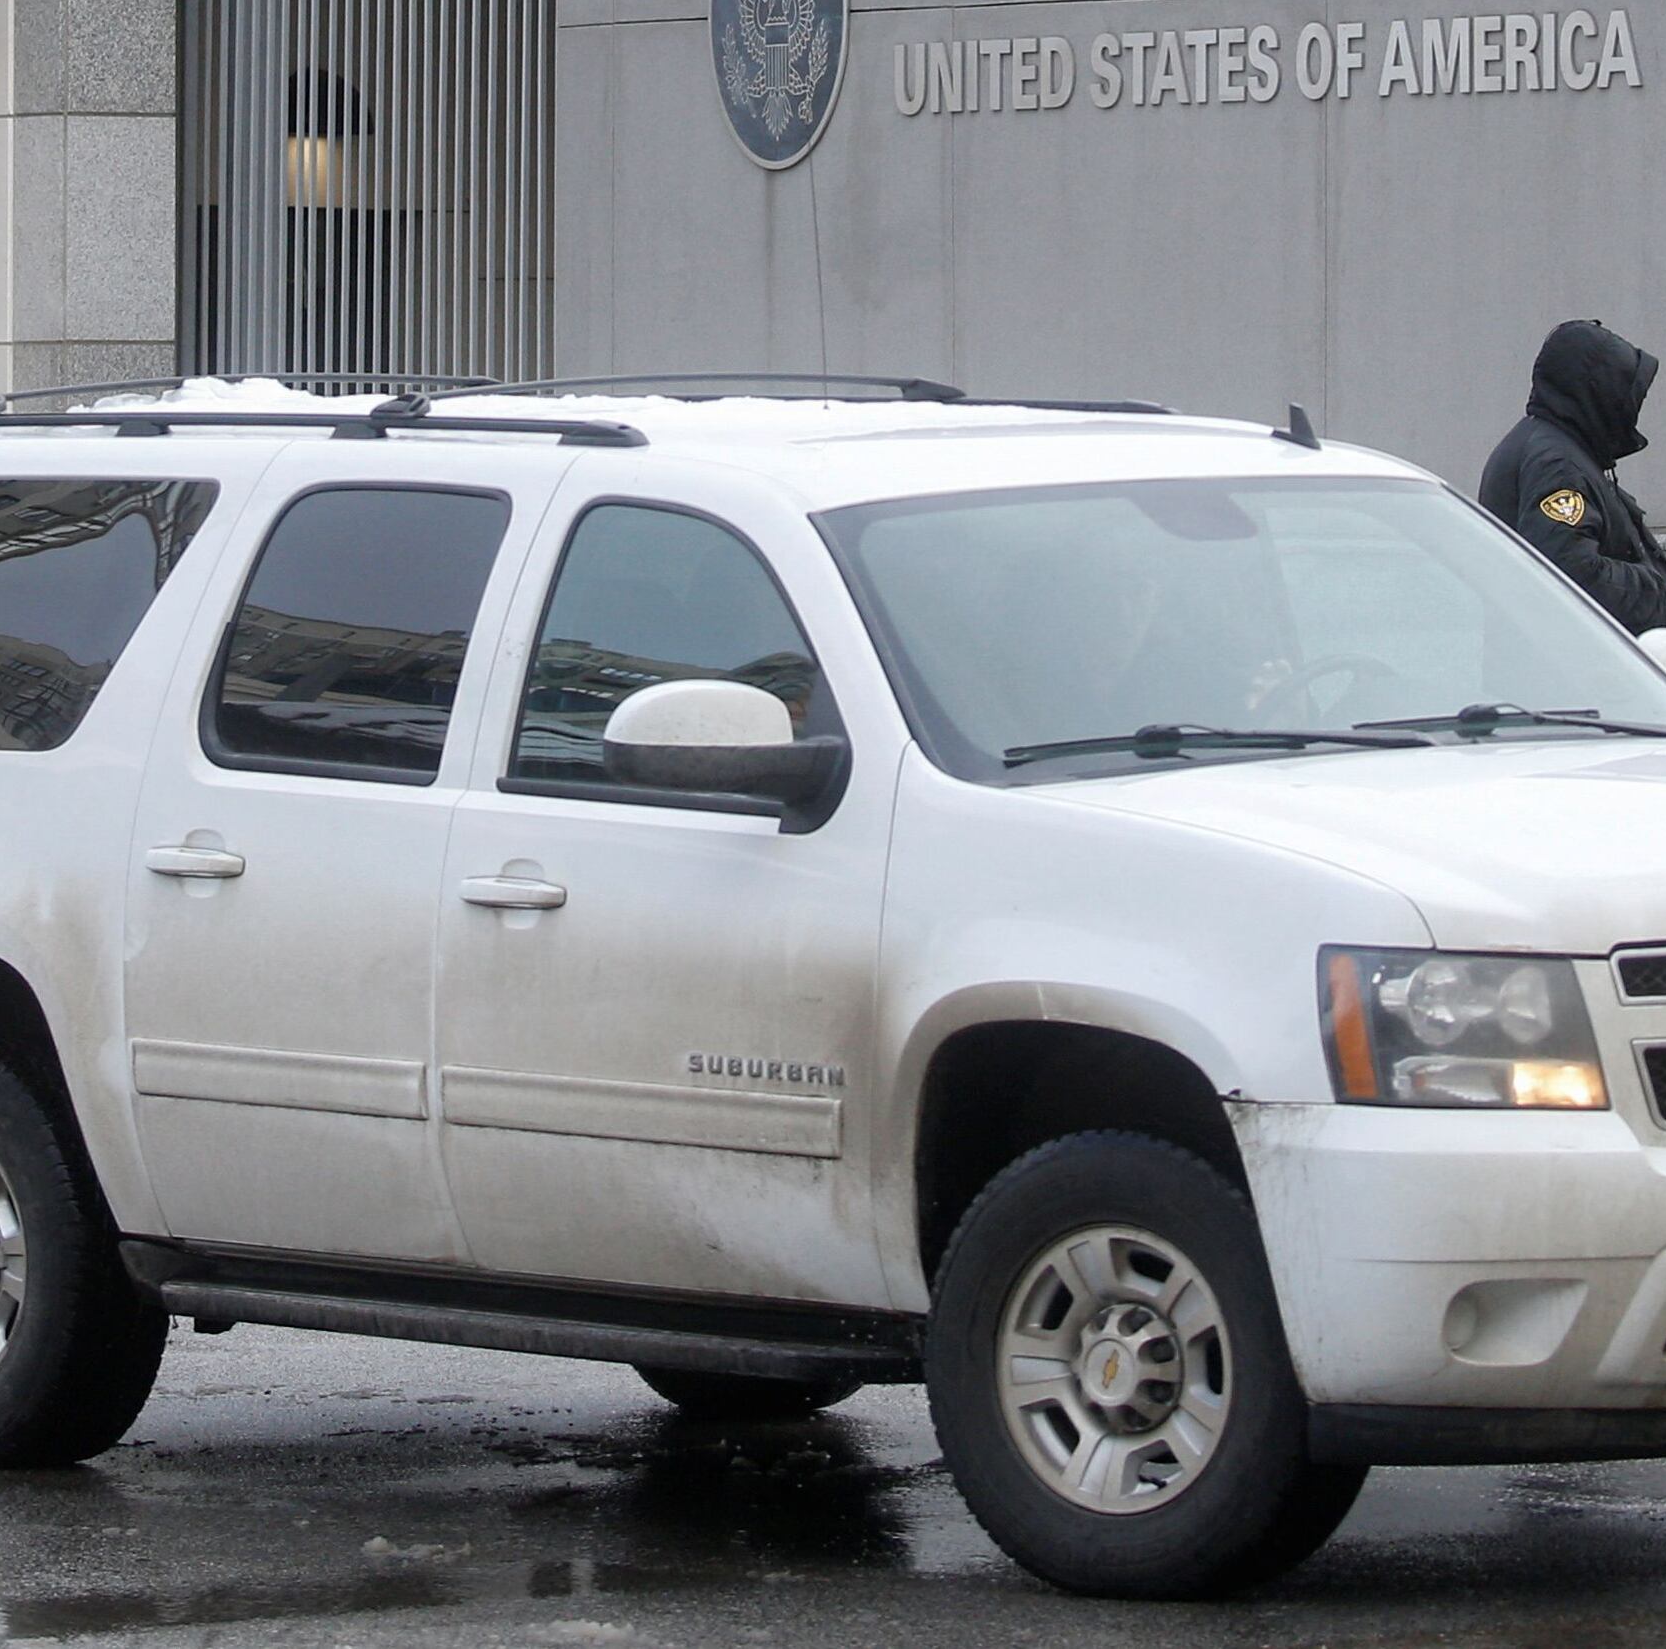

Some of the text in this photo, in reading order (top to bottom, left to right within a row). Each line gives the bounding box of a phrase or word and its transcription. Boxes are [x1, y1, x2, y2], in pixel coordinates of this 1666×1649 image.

[894, 9, 1643, 116] UNITED STATES OF AMERICA
[688, 1053, 846, 1087] SUBURBAN
